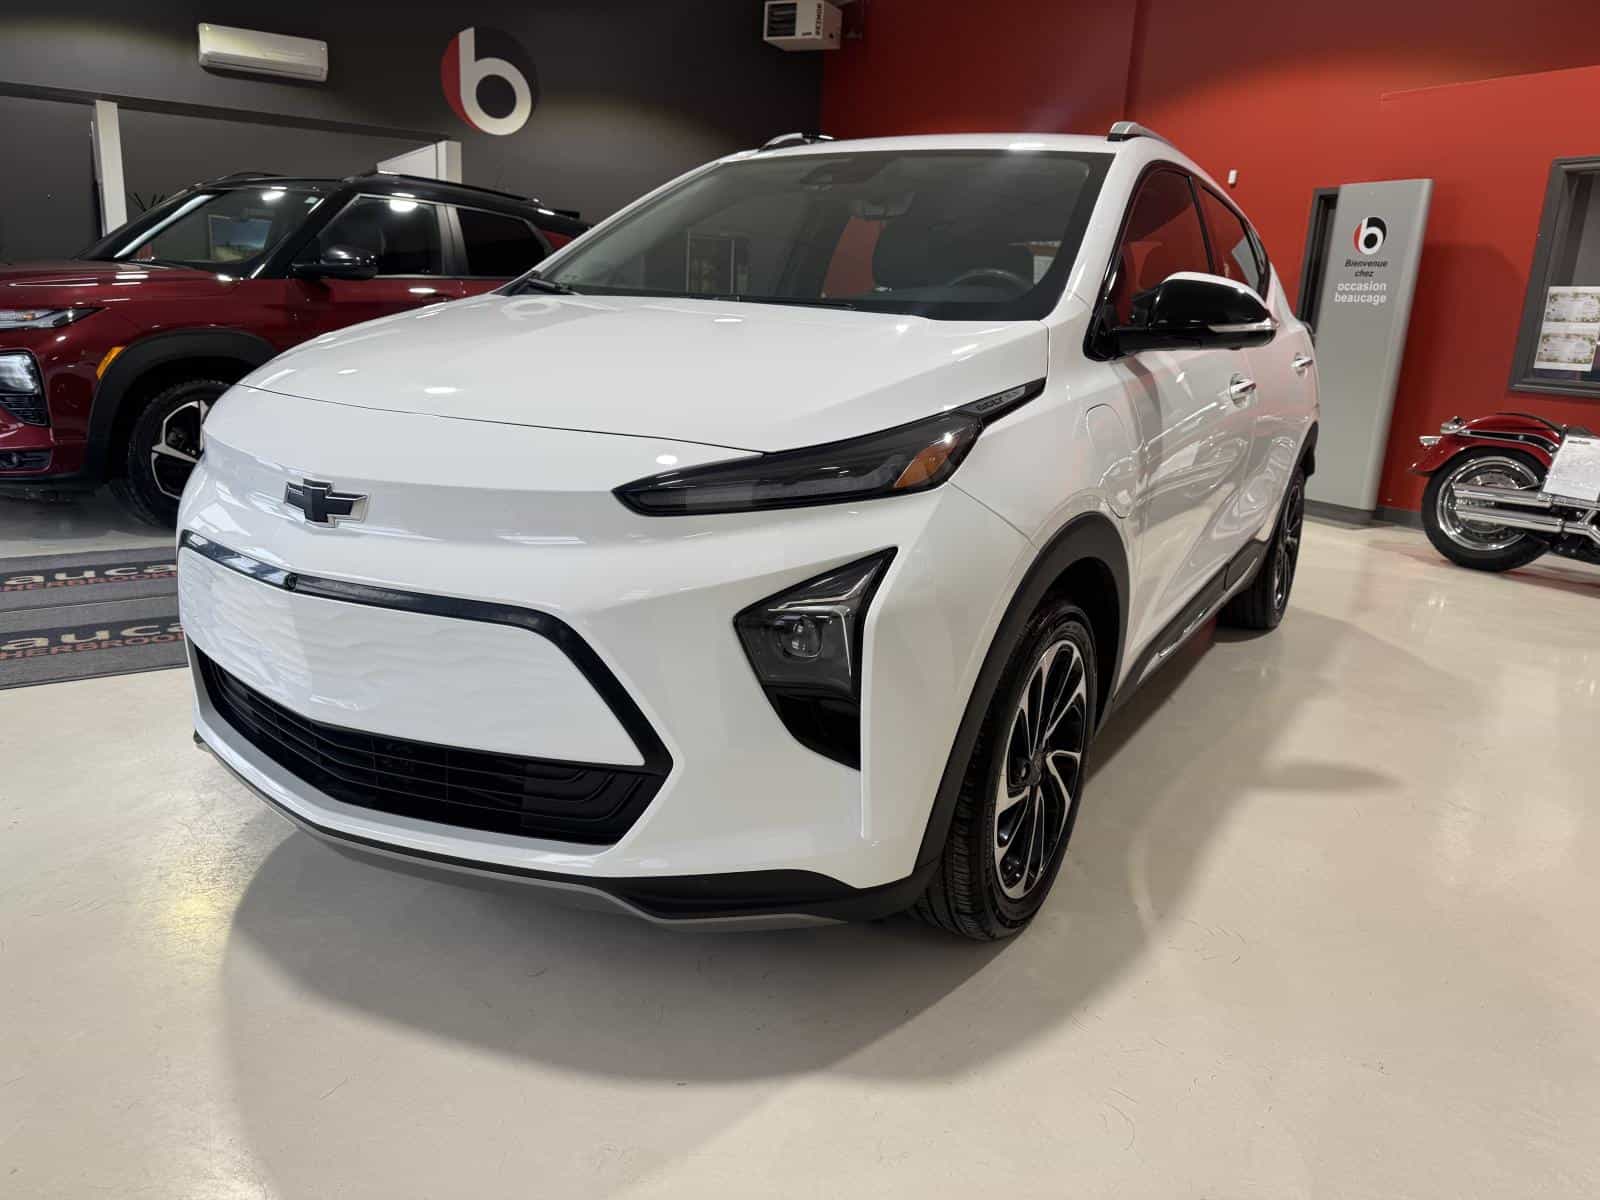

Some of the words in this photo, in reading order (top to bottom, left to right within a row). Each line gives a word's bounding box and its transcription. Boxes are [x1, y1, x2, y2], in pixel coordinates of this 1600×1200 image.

[458, 27, 533, 136] b
[1357, 217, 1384, 255] b
[1344, 258, 1388, 268] Bienvenue
[1354, 269, 1375, 278] chez
[1337, 280, 1387, 292] occasion
[1334, 292, 1387, 306] beaucage
